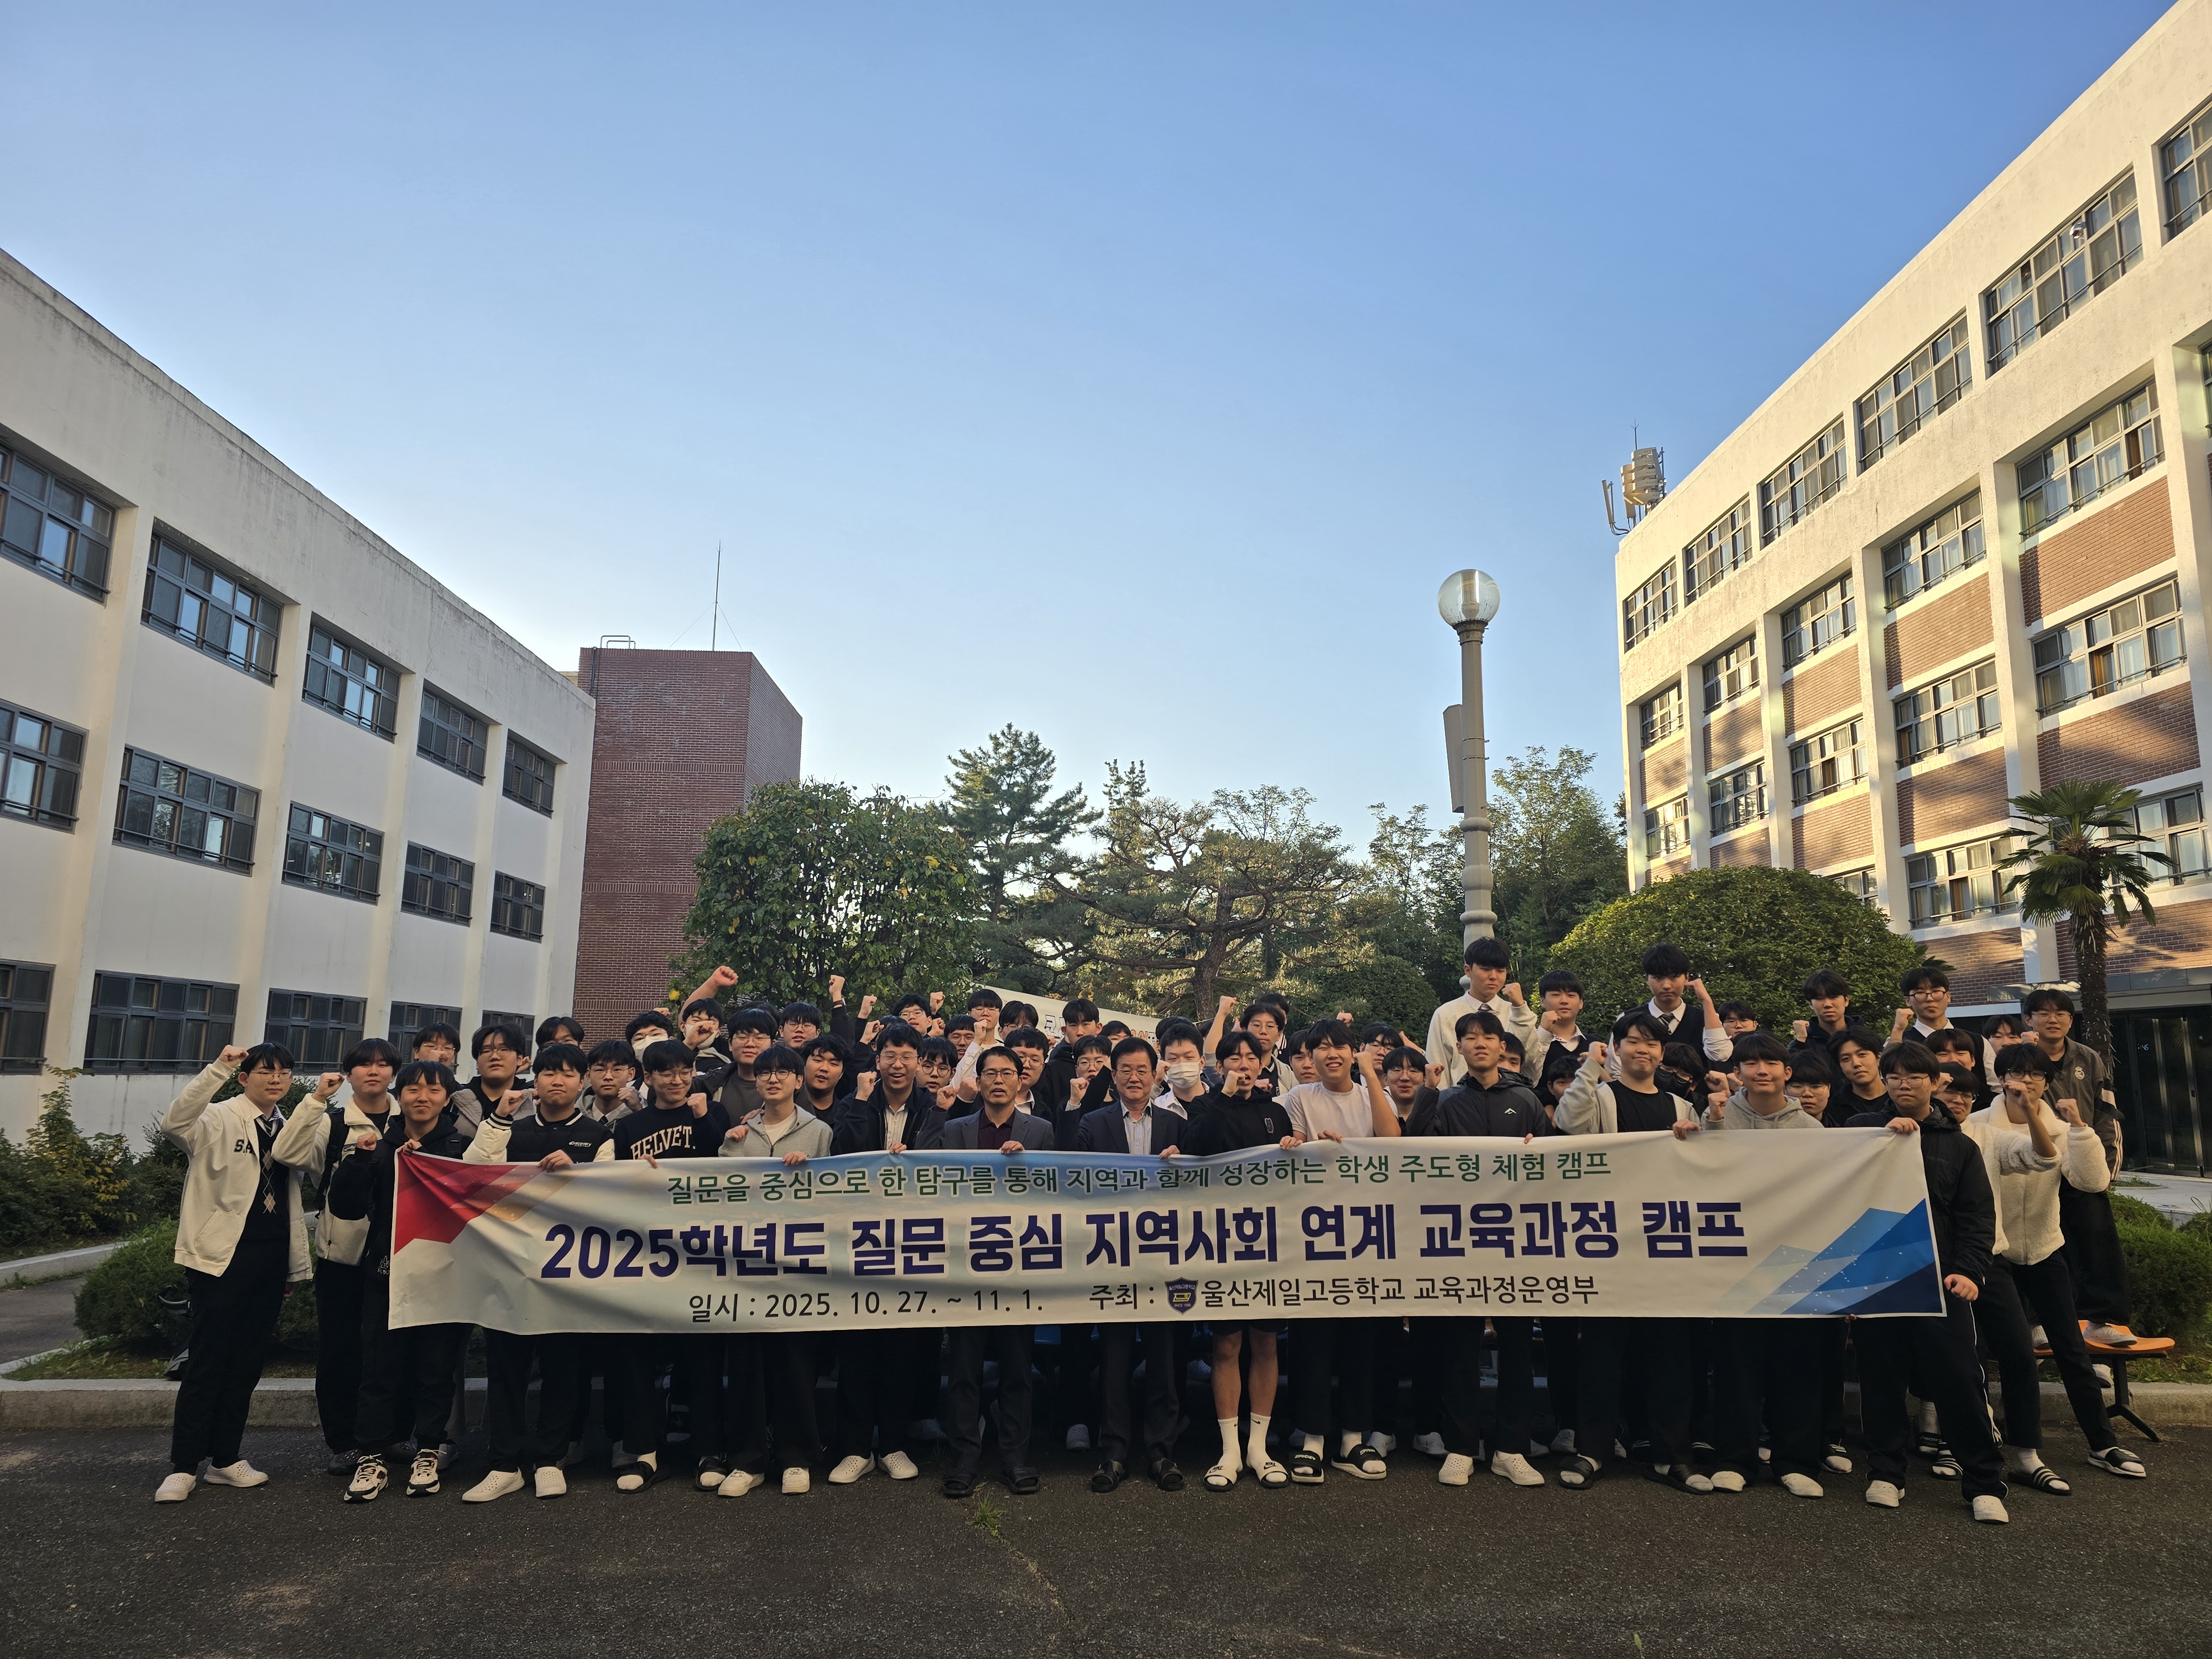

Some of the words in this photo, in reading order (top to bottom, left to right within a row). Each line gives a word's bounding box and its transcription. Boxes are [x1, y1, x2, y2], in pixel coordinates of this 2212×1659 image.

[630, 1125, 696, 1159] HELVET.
[667, 1175, 750, 1204] 질문을
[759, 1170, 870, 1201] 중심으로
[880, 1168, 906, 1196] 한
[916, 1167, 995, 1195] 탐구를
[1004, 1167, 1057, 1193] 통해
[1067, 1168, 1148, 1193] 지역과
[1157, 1166, 1208, 1188] 함께
[1219, 1160, 1327, 1186] 성장하는
[1335, 1155, 1390, 1183] 학생
[1399, 1154, 1481, 1182] 주도형
[1491, 1153, 1545, 1181] 체험
[1557, 1152, 1610, 1179] 캠프
[541, 1224, 827, 1279] 2025학년도
[852, 1218, 946, 1276] 질문
[969, 1213, 1062, 1272] 중심
[1086, 1206, 1278, 1266] 지역사회
[1301, 1204, 1396, 1261] 연계
[1420, 1201, 1619, 1258] 교육과정
[1642, 1201, 1748, 1258] 캠프
[689, 1294, 739, 1323] 일시
[764, 1293, 839, 1318] 2025.
[851, 1292, 888, 1315] 10.
[898, 1291, 937, 1314] 27.
[973, 1290, 1011, 1312] 11.
[1021, 1290, 1043, 1311] 1.
[1089, 1283, 1138, 1310] 주최
[1201, 1277, 1406, 1308] 울산제일고등학교
[1414, 1276, 1599, 1305] 교육과정운영부
